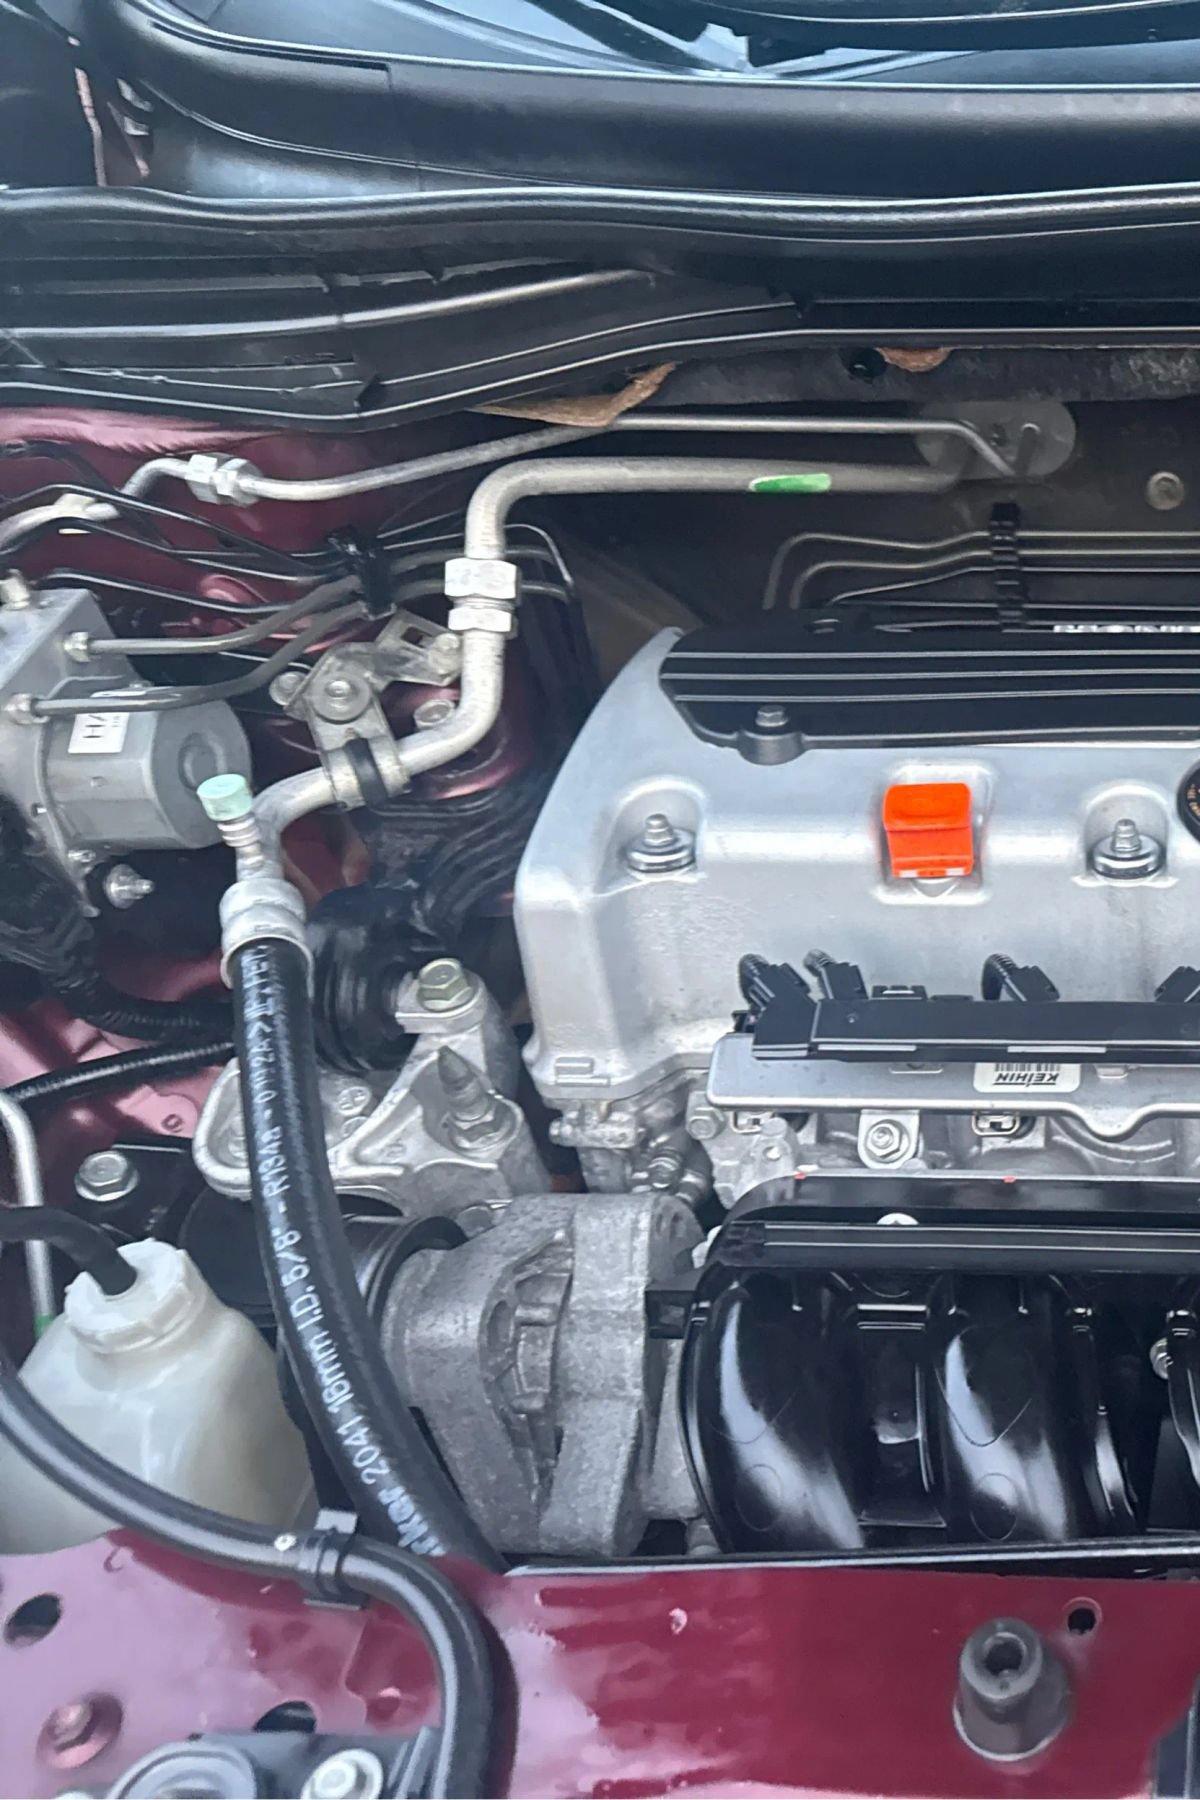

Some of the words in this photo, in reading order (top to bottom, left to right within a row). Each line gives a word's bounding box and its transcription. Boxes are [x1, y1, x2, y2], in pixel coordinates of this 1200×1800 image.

[993, 1072, 1059, 1087] KEIHIN
[290, 1284, 324, 1331] I.D.
[309, 1330, 355, 1414] 16mm
[337, 1415, 391, 1485] 2041
[377, 1486, 446, 1557] rker
